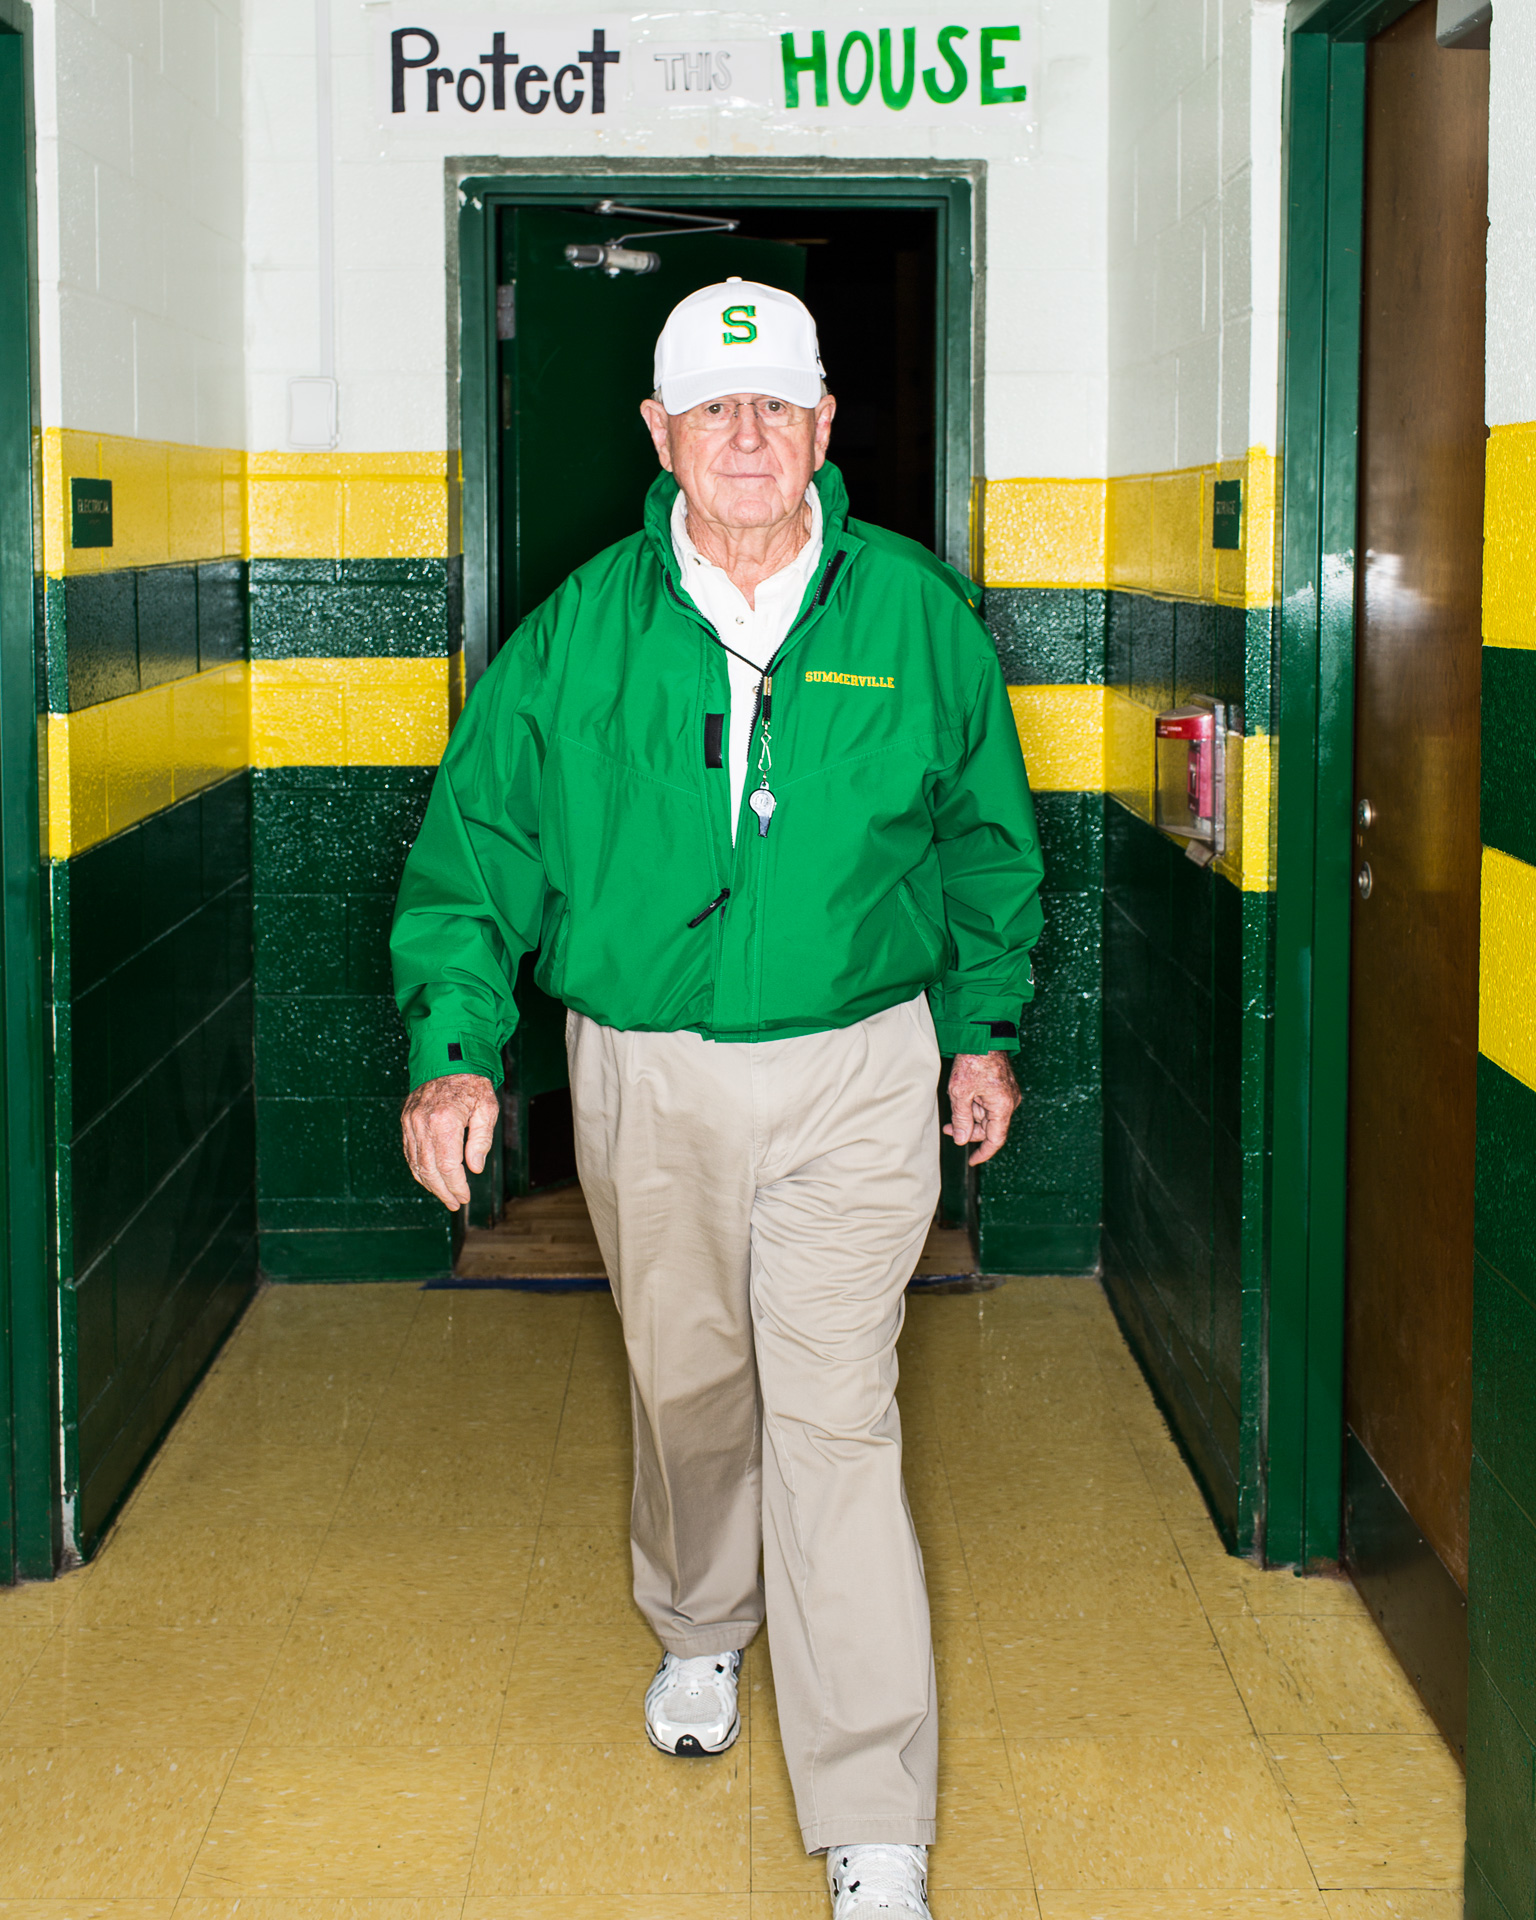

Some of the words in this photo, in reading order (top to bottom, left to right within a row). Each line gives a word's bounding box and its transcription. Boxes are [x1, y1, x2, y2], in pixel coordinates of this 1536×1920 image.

[391, 27, 620, 115] Protect
[653, 51, 732, 92] THIS
[780, 25, 1028, 111] HOUSE
[721, 305, 758, 346] S
[805, 670, 895, 689] SUMMERVILLE
